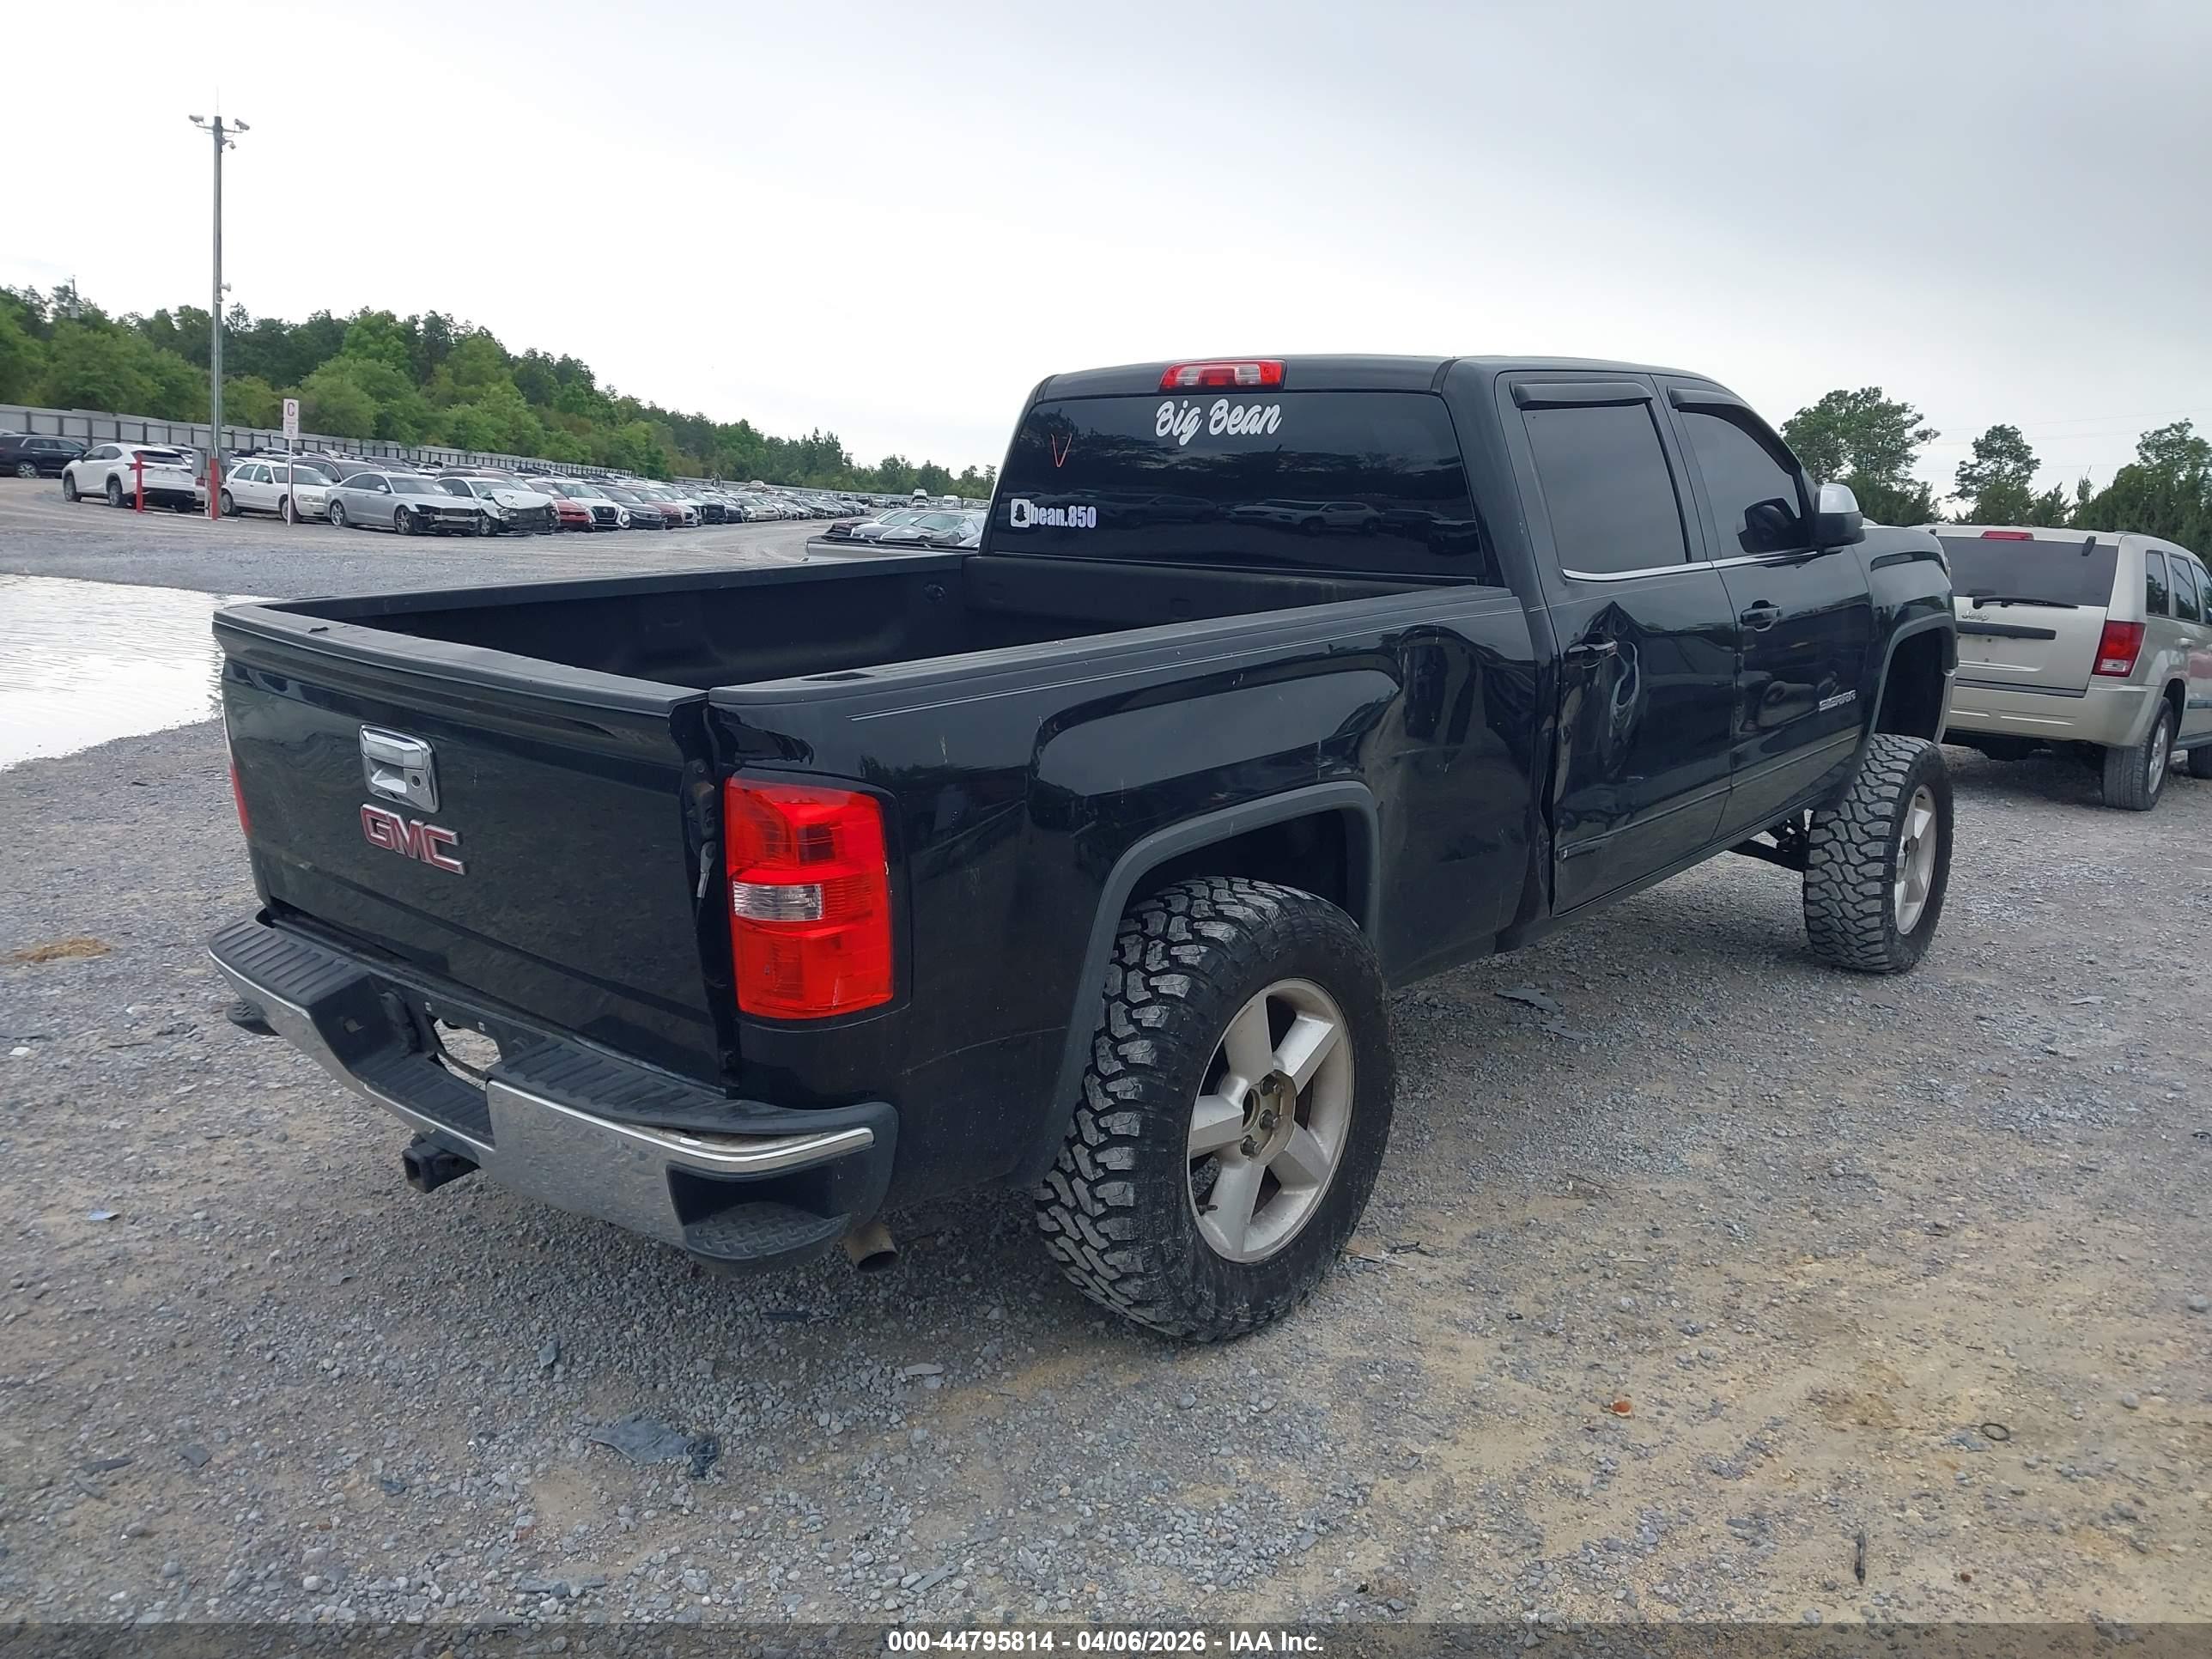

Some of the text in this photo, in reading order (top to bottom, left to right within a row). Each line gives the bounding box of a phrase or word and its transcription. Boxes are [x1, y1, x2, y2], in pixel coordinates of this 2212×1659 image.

[287, 402, 295, 417] C
[1156, 398, 1283, 447] Big Bean
[1030, 503, 1097, 529] bean.850
[360, 803, 466, 876] GMC
